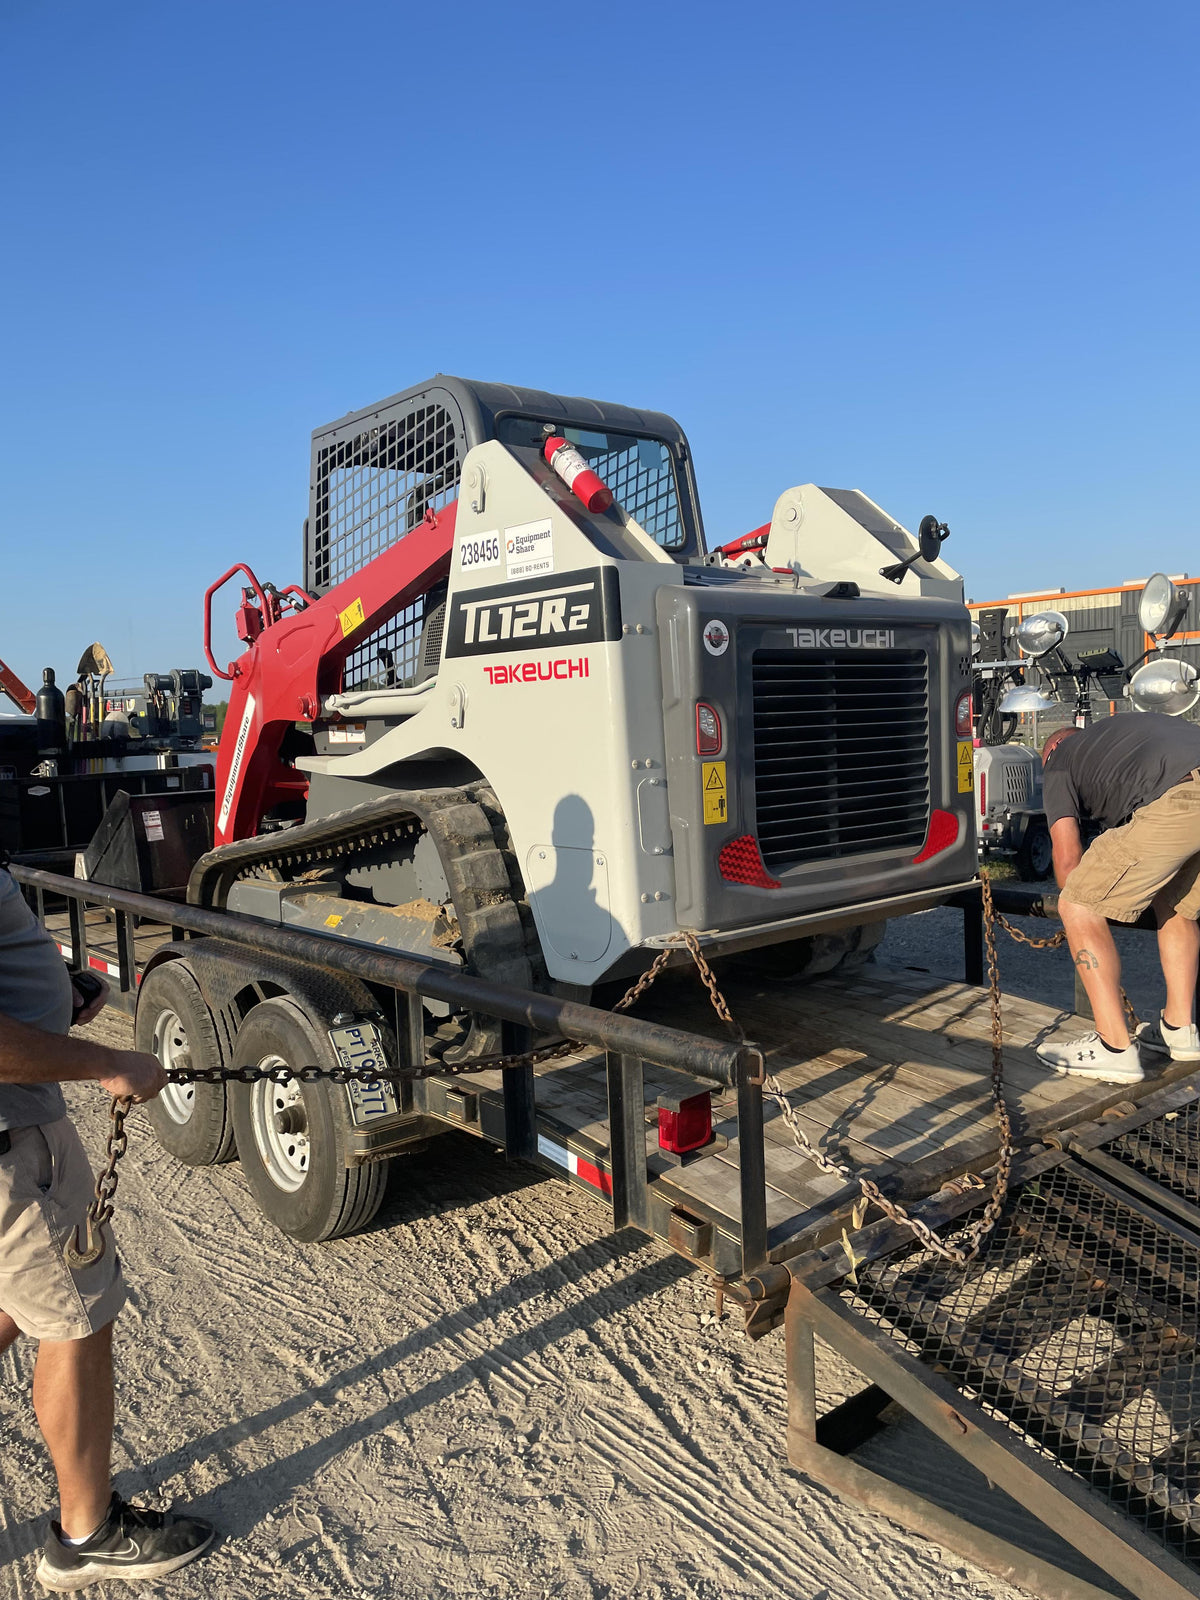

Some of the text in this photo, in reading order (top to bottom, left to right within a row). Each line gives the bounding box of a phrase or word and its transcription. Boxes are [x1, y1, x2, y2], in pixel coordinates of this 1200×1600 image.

[515, 530, 551, 545] Equipment
[516, 544, 535, 554] Share
[461, 538, 499, 566] 238456
[460, 582, 595, 644] TL12R2
[786, 628, 895, 648] TAKEUCHI
[483, 657, 590, 685] TAKEUCHI
[225, 717, 249, 804] EquipmentShare
[345, 1028, 388, 1114] PT19977
